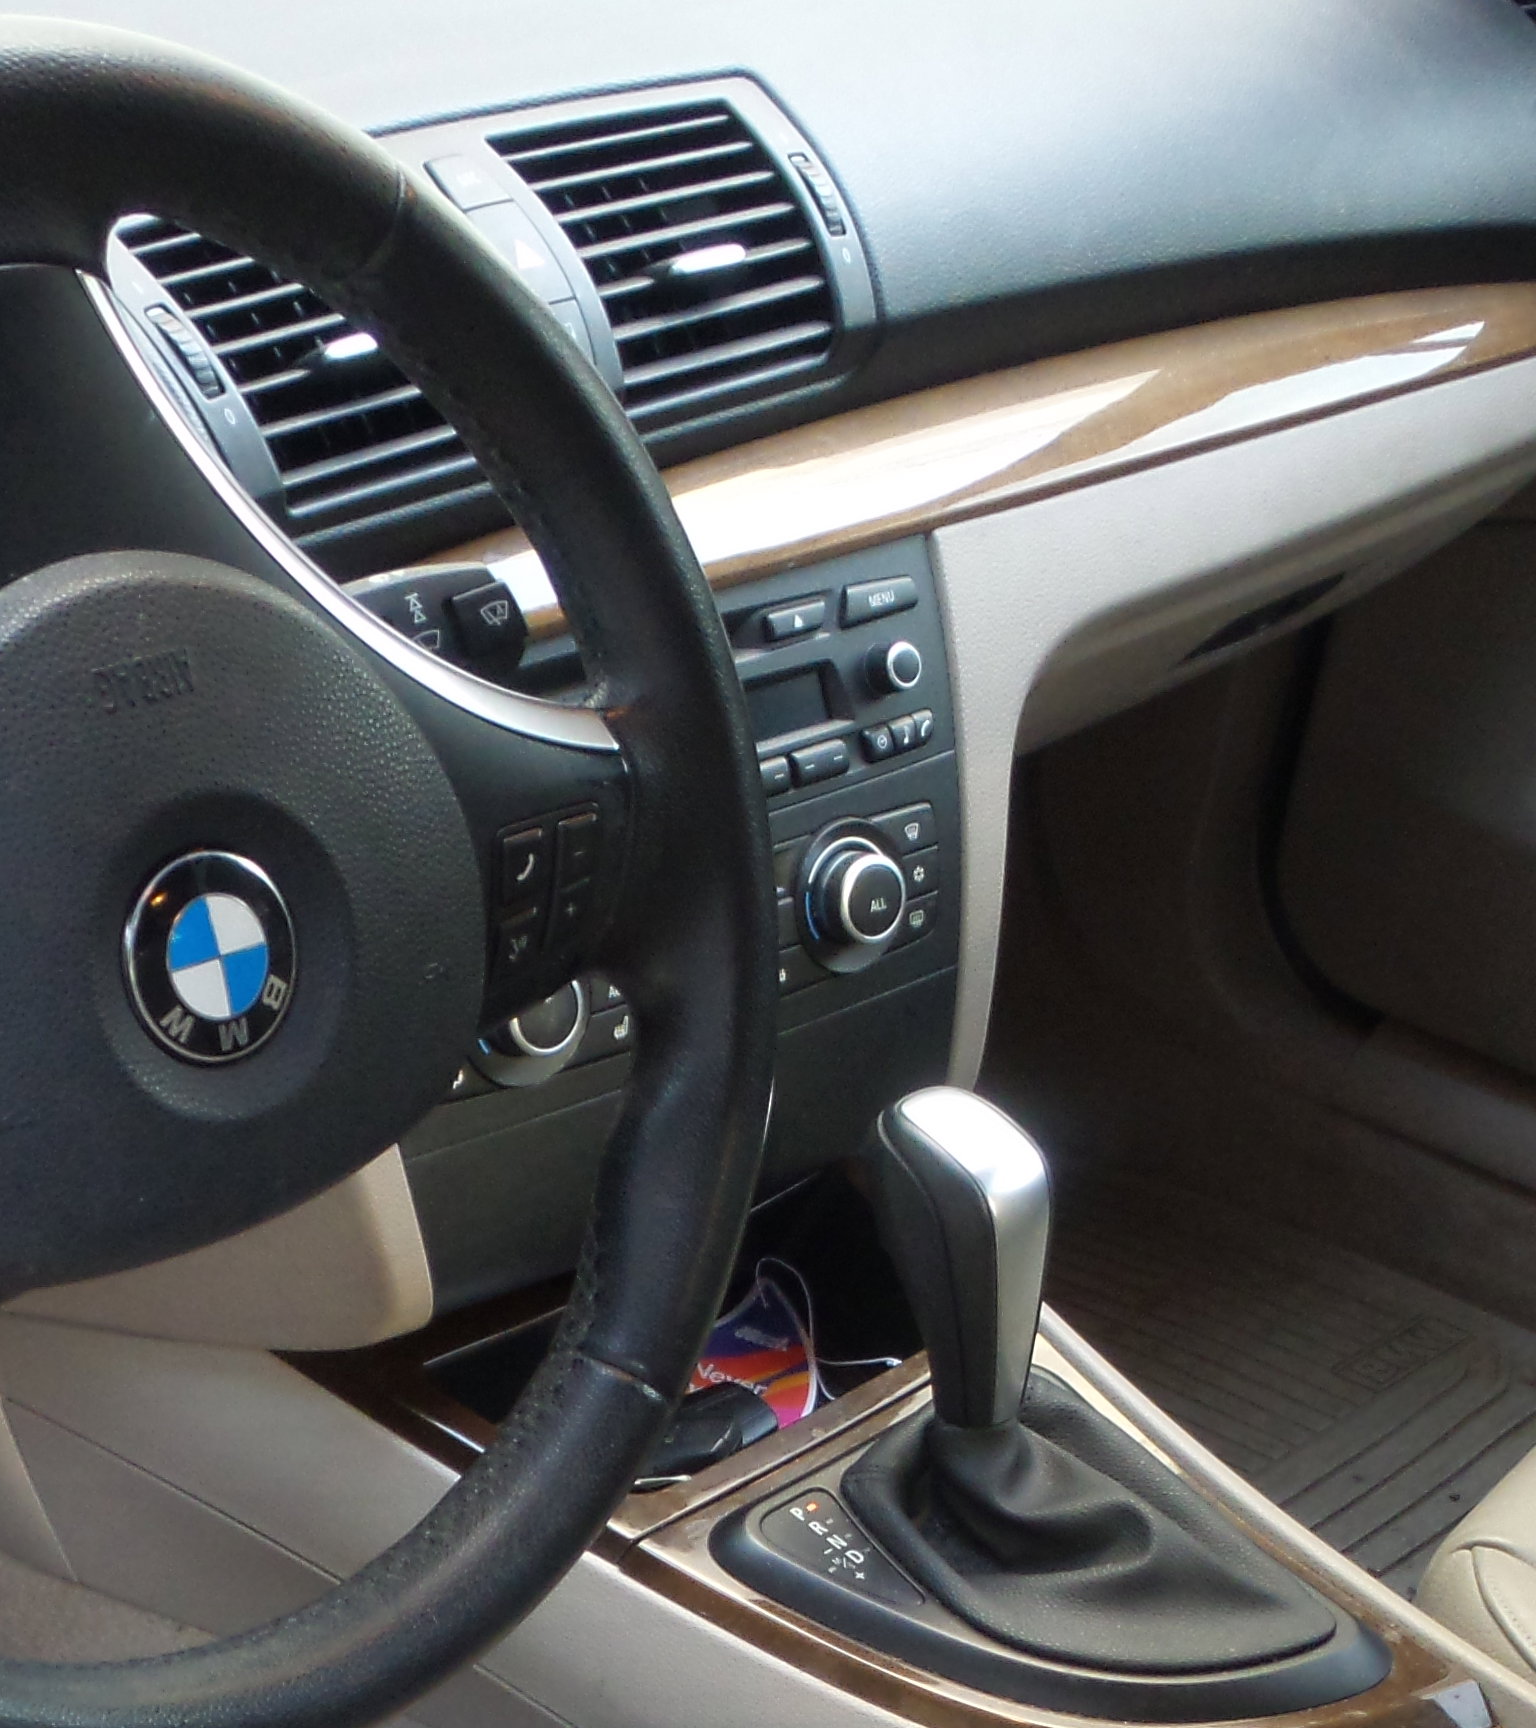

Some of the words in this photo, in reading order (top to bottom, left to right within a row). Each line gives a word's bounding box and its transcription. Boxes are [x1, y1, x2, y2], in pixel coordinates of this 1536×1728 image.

[868, 590, 895, 607] MENU
[870, 898, 887, 912] ALL
[160, 974, 288, 1051] BMW
[789, 1507, 805, 1521] P
[808, 1521, 829, 1536] R
[826, 1534, 848, 1550] N
[844, 1550, 864, 1564] D
